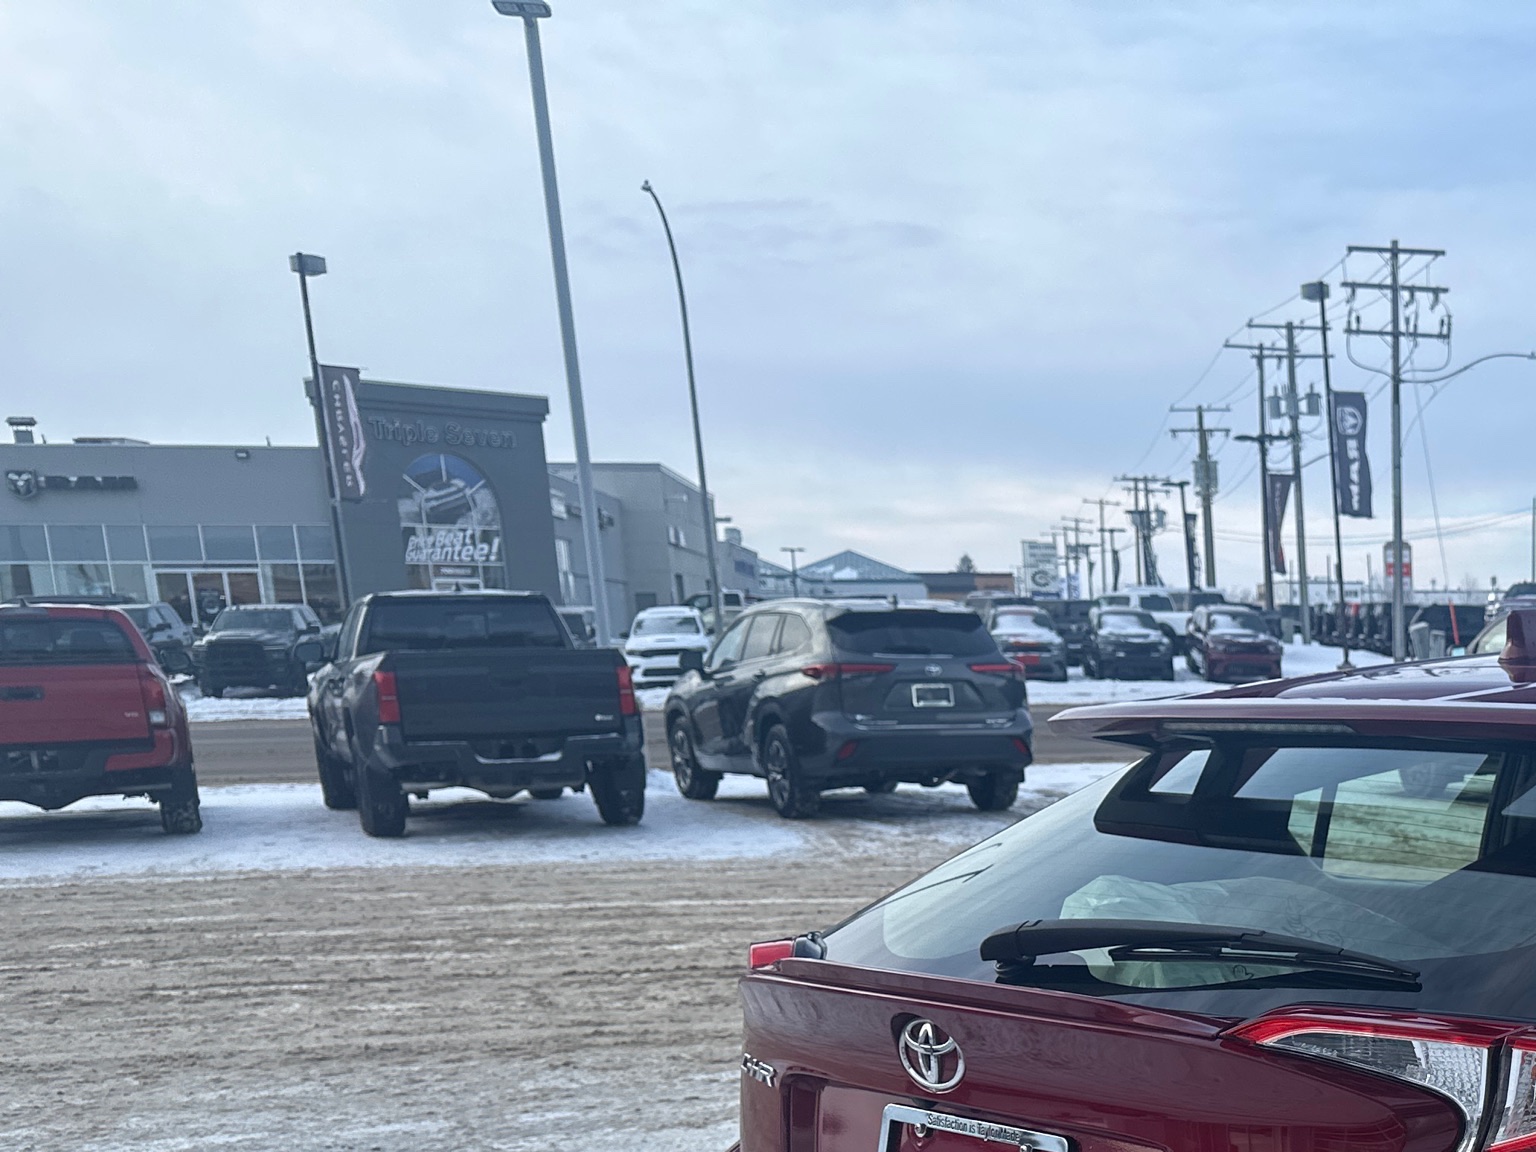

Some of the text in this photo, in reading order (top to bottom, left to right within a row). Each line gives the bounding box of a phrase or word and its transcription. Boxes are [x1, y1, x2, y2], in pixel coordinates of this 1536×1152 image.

[368, 415, 517, 449] Triple Seven
[405, 536, 500, 562] Guarantee!
[436, 528, 474, 547] Beat
[927, 1112, 969, 1133] Satisfaction
[968, 1121, 977, 1133] is
